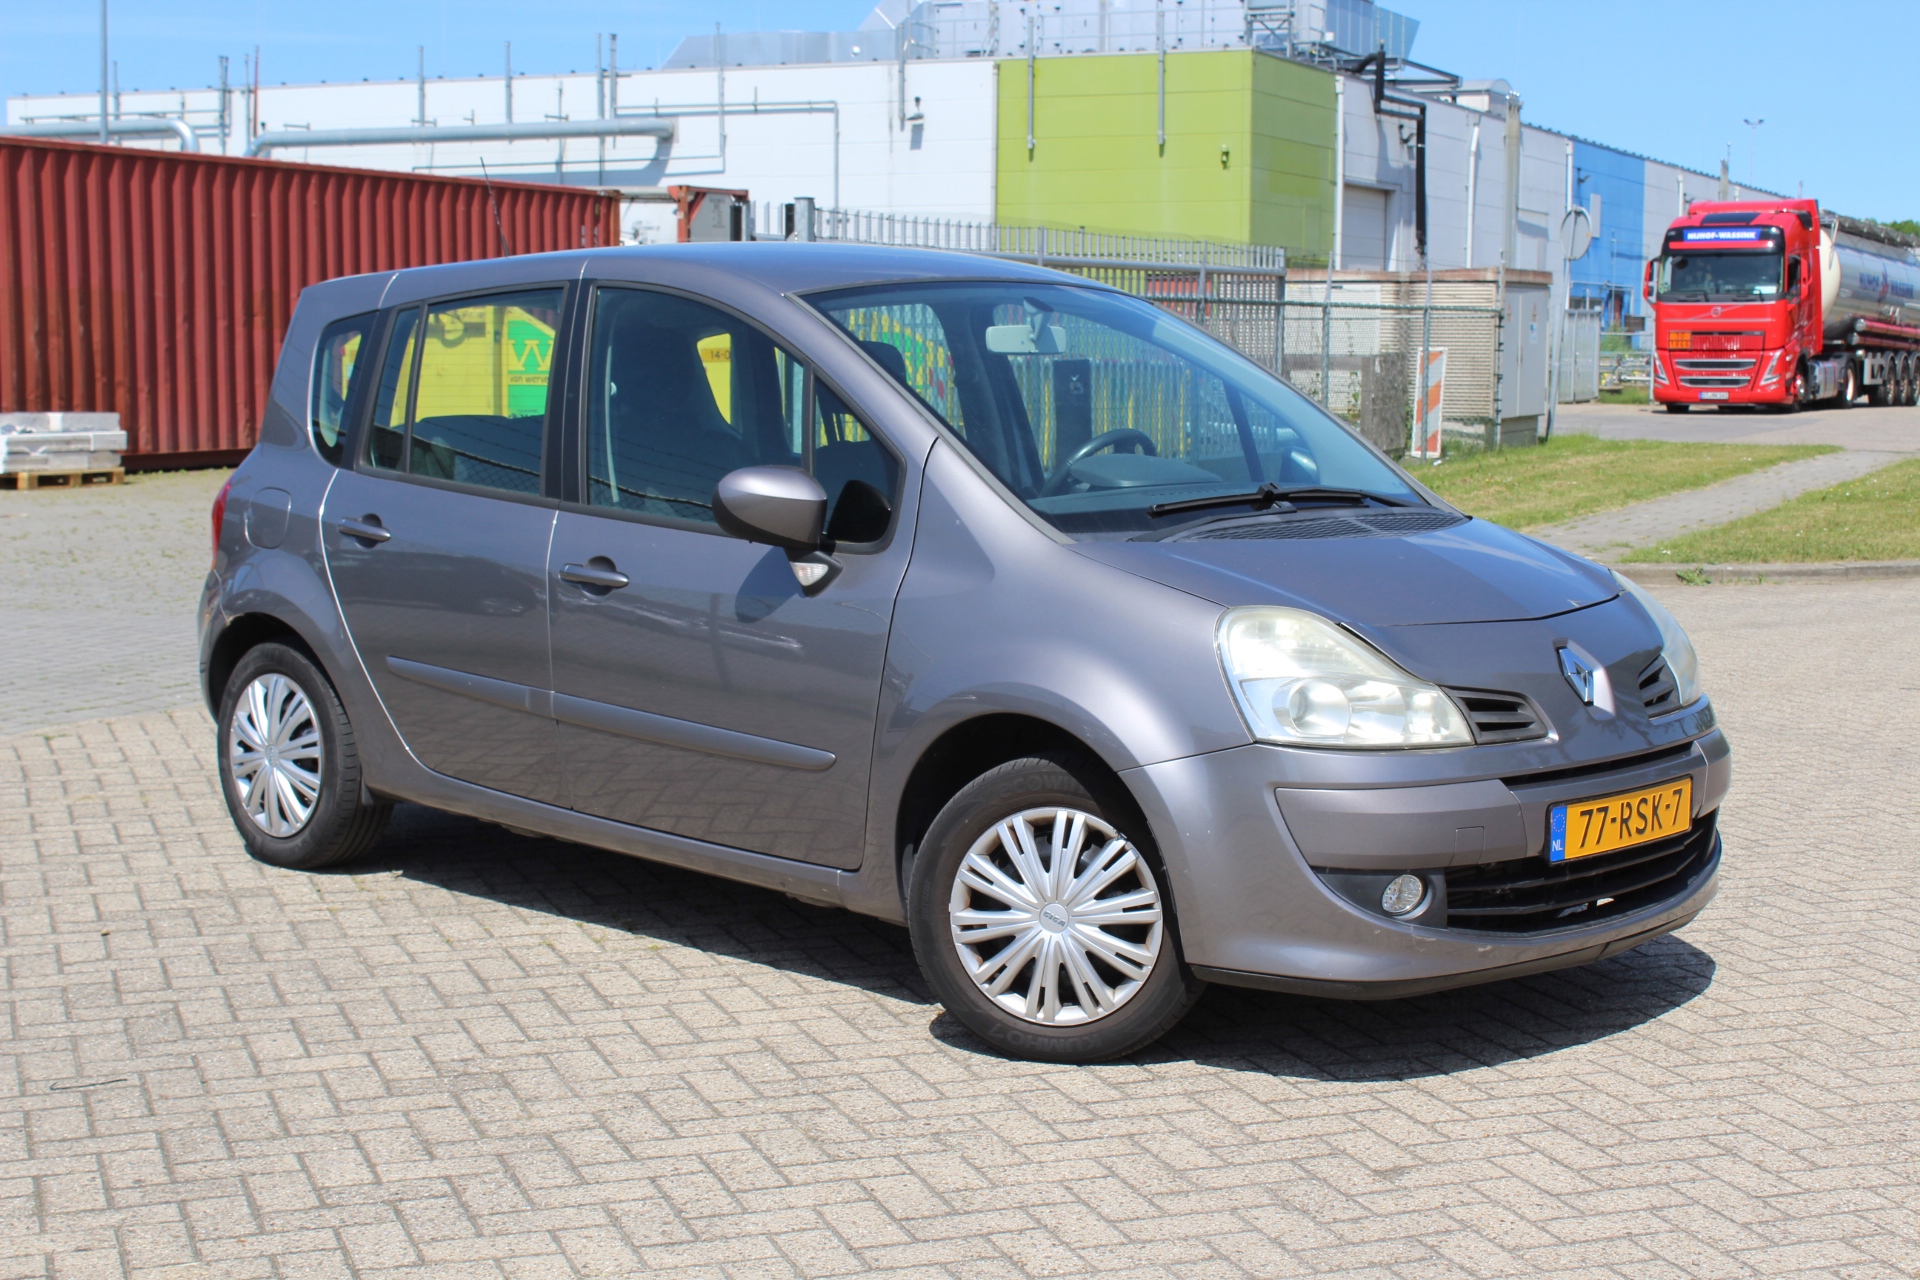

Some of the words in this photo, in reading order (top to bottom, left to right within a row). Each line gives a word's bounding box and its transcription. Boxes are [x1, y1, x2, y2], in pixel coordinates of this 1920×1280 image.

[1687, 231, 1757, 240] NIJHOF-WASSINK
[1579, 788, 1683, 849] 77-RSK-7
[1552, 839, 1563, 851] NL
